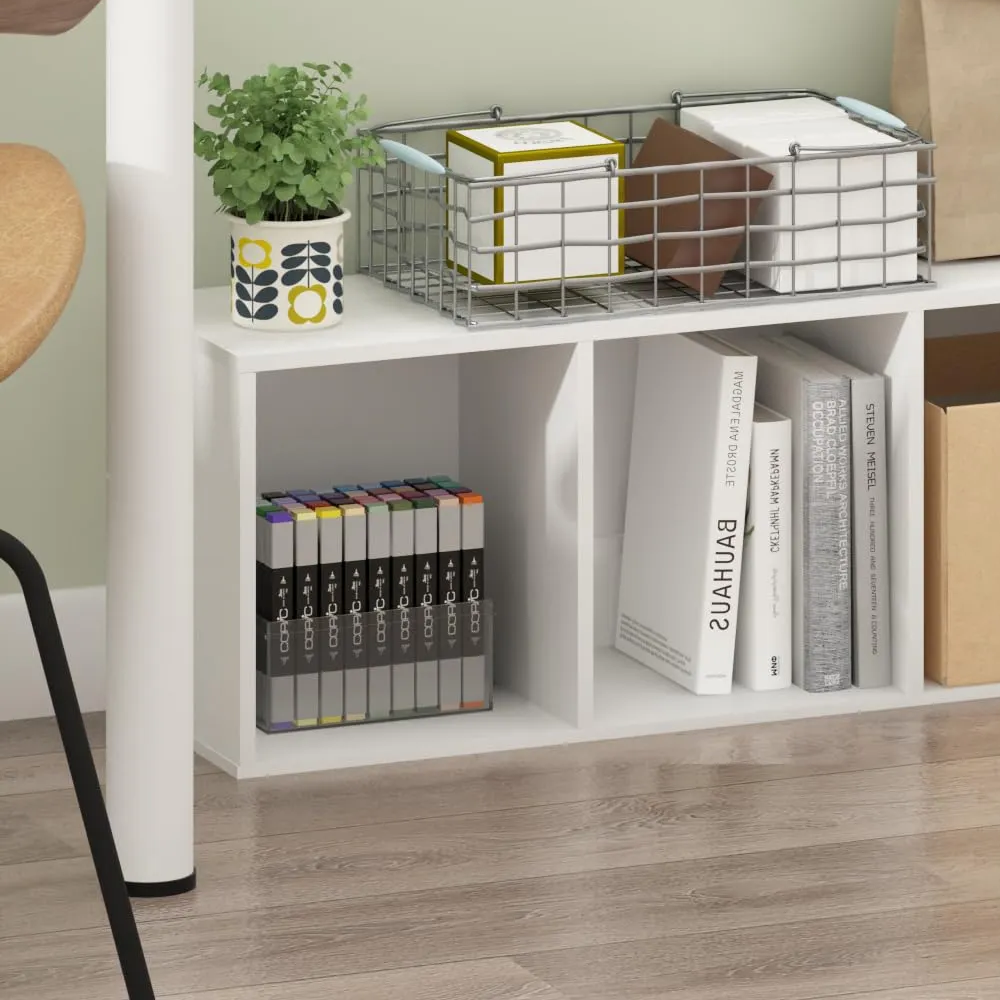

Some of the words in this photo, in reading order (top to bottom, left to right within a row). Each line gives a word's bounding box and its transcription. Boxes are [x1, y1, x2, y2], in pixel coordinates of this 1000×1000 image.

[826, 400, 837, 436] BRAD
[838, 399, 848, 442] ALLIED
[866, 403, 876, 445] STEVEN
[812, 401, 824, 483] OCCUPATION
[839, 445, 848, 490] WORKS
[866, 452, 877, 492] MEISEL
[839, 493, 849, 591] ARCHITECTURE
